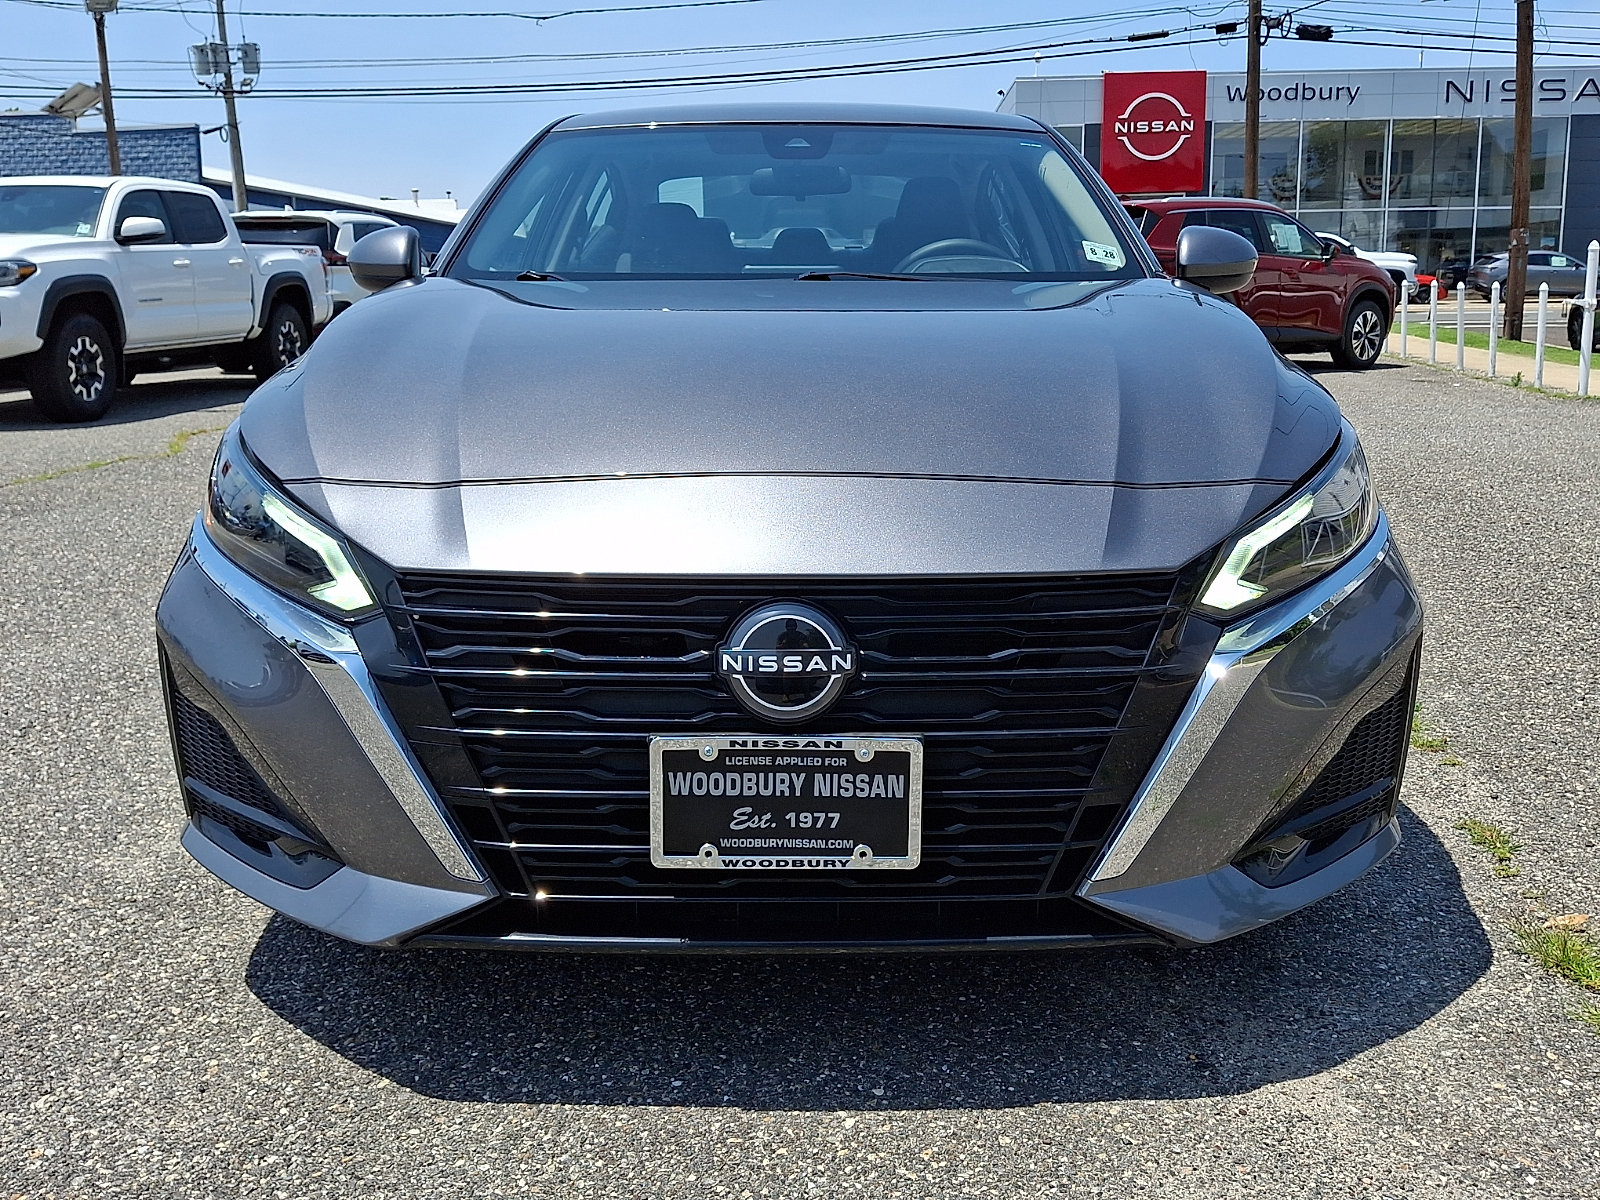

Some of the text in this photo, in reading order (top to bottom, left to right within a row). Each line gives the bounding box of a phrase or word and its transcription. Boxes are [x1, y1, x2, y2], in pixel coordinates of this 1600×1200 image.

[1114, 119, 1195, 134] NISSAN
[1103, 250, 1115, 259] 28
[722, 653, 853, 673] NISSAN
[729, 740, 844, 749] NISSAN
[725, 756, 847, 767] LICENSE APPLIED FOR
[668, 772, 905, 799] WOODBURY NISSAN
[729, 806, 841, 830] Est. 1977
[719, 838, 854, 850] WOODBURYNISSAN.COM
[721, 859, 851, 868] WOODBURY
